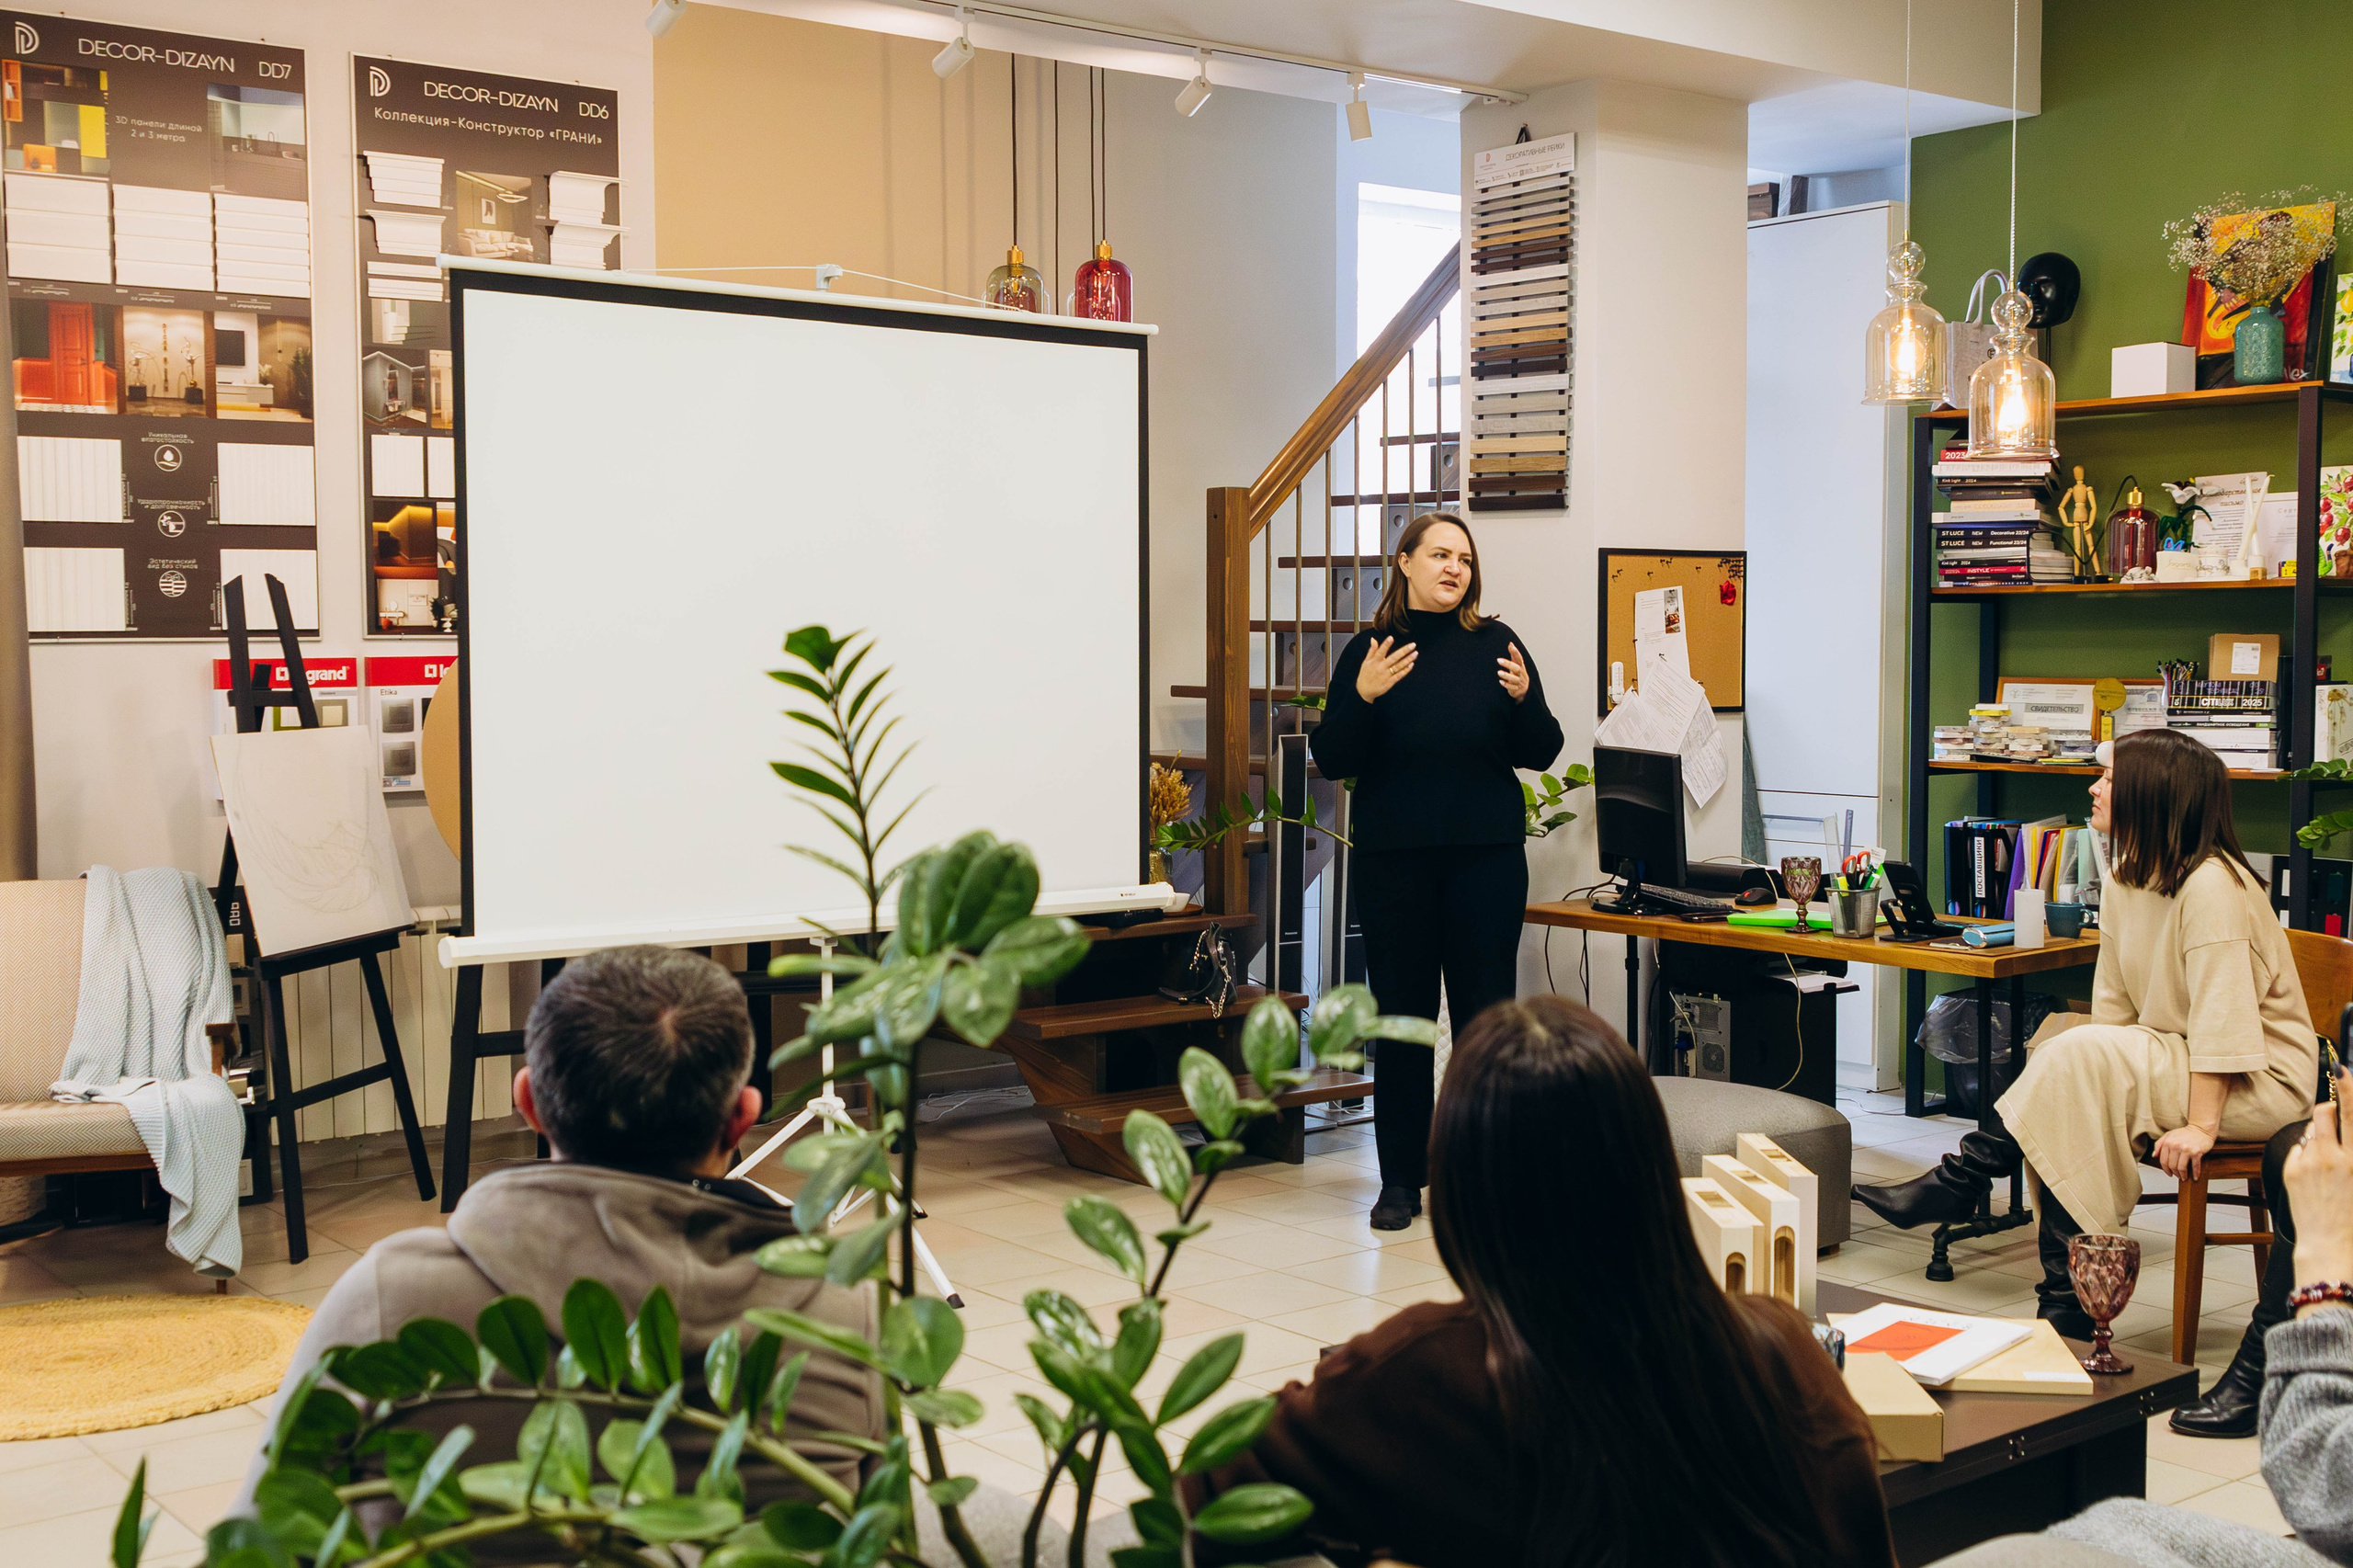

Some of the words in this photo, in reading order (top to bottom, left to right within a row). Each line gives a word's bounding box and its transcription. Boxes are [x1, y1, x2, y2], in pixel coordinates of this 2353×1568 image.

[78, 38, 235, 73] DECOR-DIZAYN
[258, 61, 292, 80] DD7
[424, 81, 559, 113] DECOR-DIZAYN
[578, 101, 609, 120] DD6
[115, 115, 128, 125] 3D
[131, 119, 165, 129] панели
[167, 122, 202, 133] длиной
[374, 107, 545, 140] Коллекция-Конструктор
[549, 128, 603, 146] «ГРАНИ»
[131, 129, 137, 138] 2
[147, 130, 154, 139] 3
[156, 132, 186, 142] метра
[1506, 145, 1547, 163] ДЕКОРАТИВНЫЕ
[305, 665, 347, 686] grand
[2030, 705, 2079, 714] СВИДЕТЕЛЬСТВО
[2243, 699, 2263, 707] 2025
